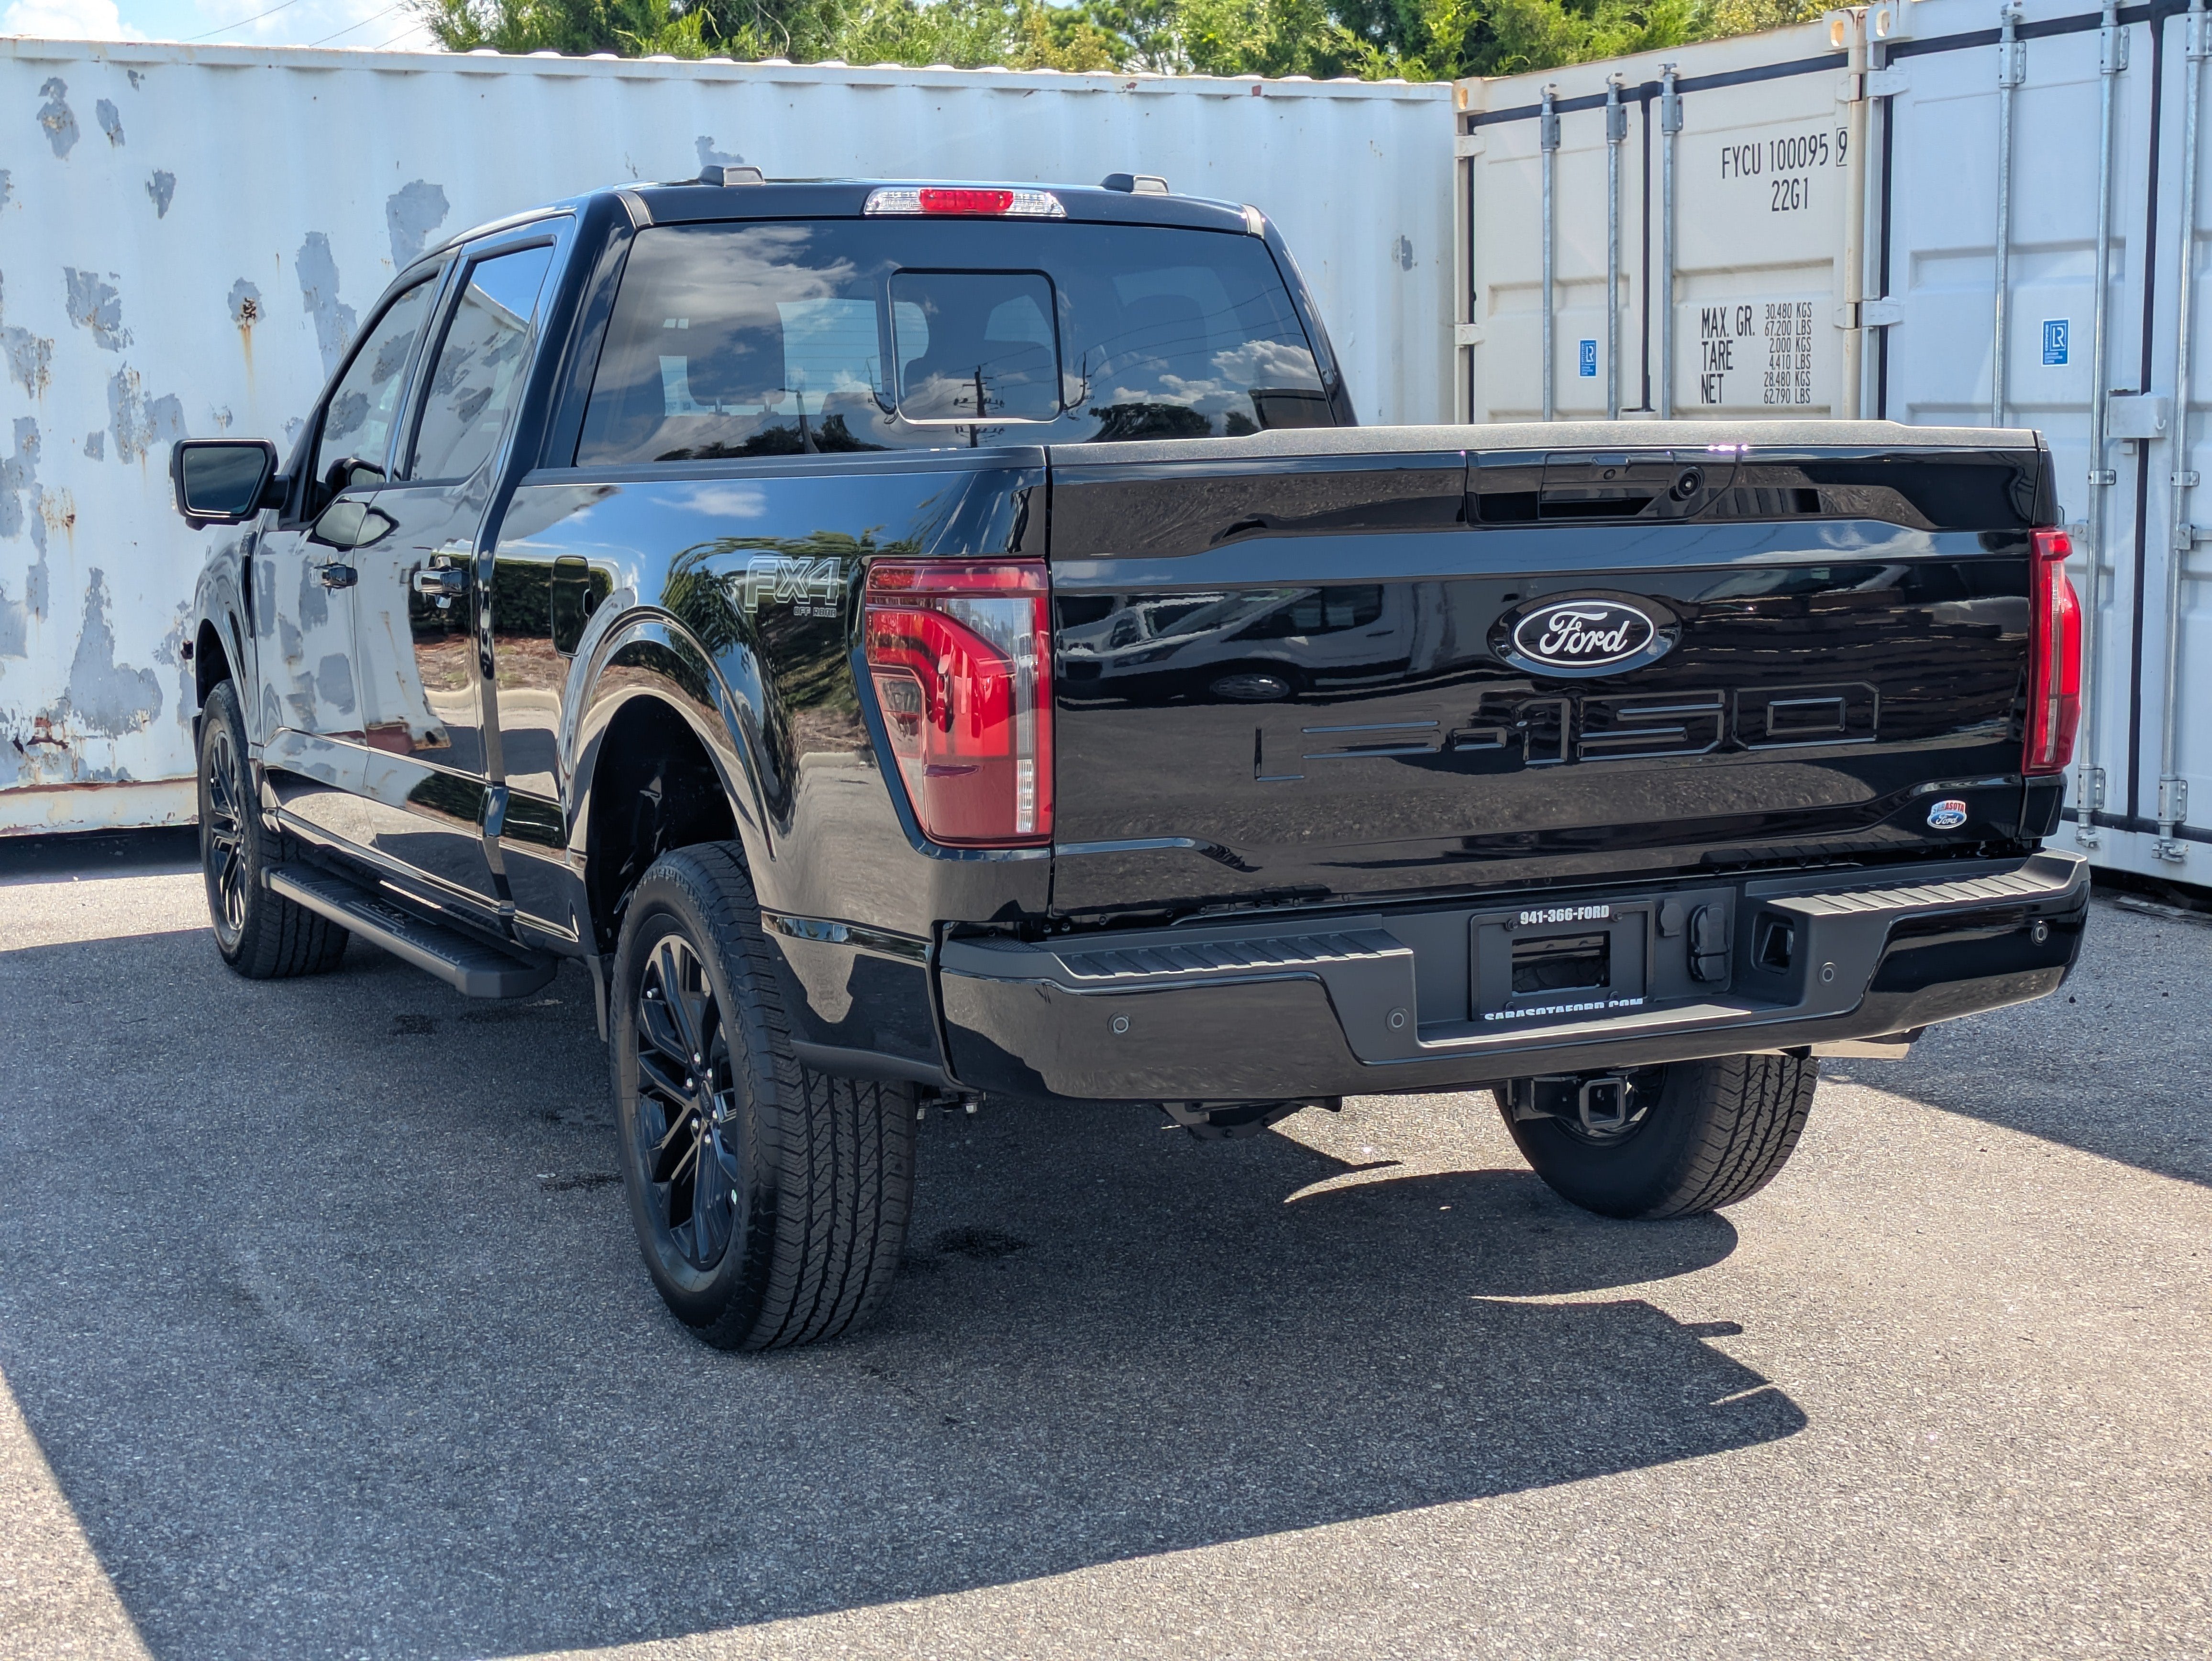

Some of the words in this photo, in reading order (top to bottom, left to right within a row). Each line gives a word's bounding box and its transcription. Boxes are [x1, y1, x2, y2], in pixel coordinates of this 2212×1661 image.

[1722, 143, 1761, 179] FYCU
[1770, 133, 1829, 172] 100095
[1838, 130, 1847, 163] 9
[1771, 177, 1809, 211] 22G1
[1765, 302, 1792, 320] 30.480
[1796, 302, 1812, 318] KGS
[1701, 306, 1729, 339] MAX.
[1736, 305, 1755, 337] GR.
[1764, 320, 1792, 337] 67.200
[1796, 319, 1812, 335] LBS
[1769, 337, 1791, 353] 2.000
[1795, 336, 1812, 353] KGS
[1701, 340, 1734, 371] TARE
[1769, 354, 1791, 370] 4.410
[1795, 354, 1811, 370] LBS
[1701, 373, 1724, 404] NET
[1764, 371, 1791, 388] 28.480
[1795, 371, 1811, 387] KGS
[1764, 388, 1791, 404] 62.790
[1795, 388, 1811, 404] LBS
[743, 556, 841, 613] FX4
[1539, 611, 1630, 655] Ford
[1936, 813, 1959, 825] Ford
[1519, 905, 1610, 925] 941-366-FORD
